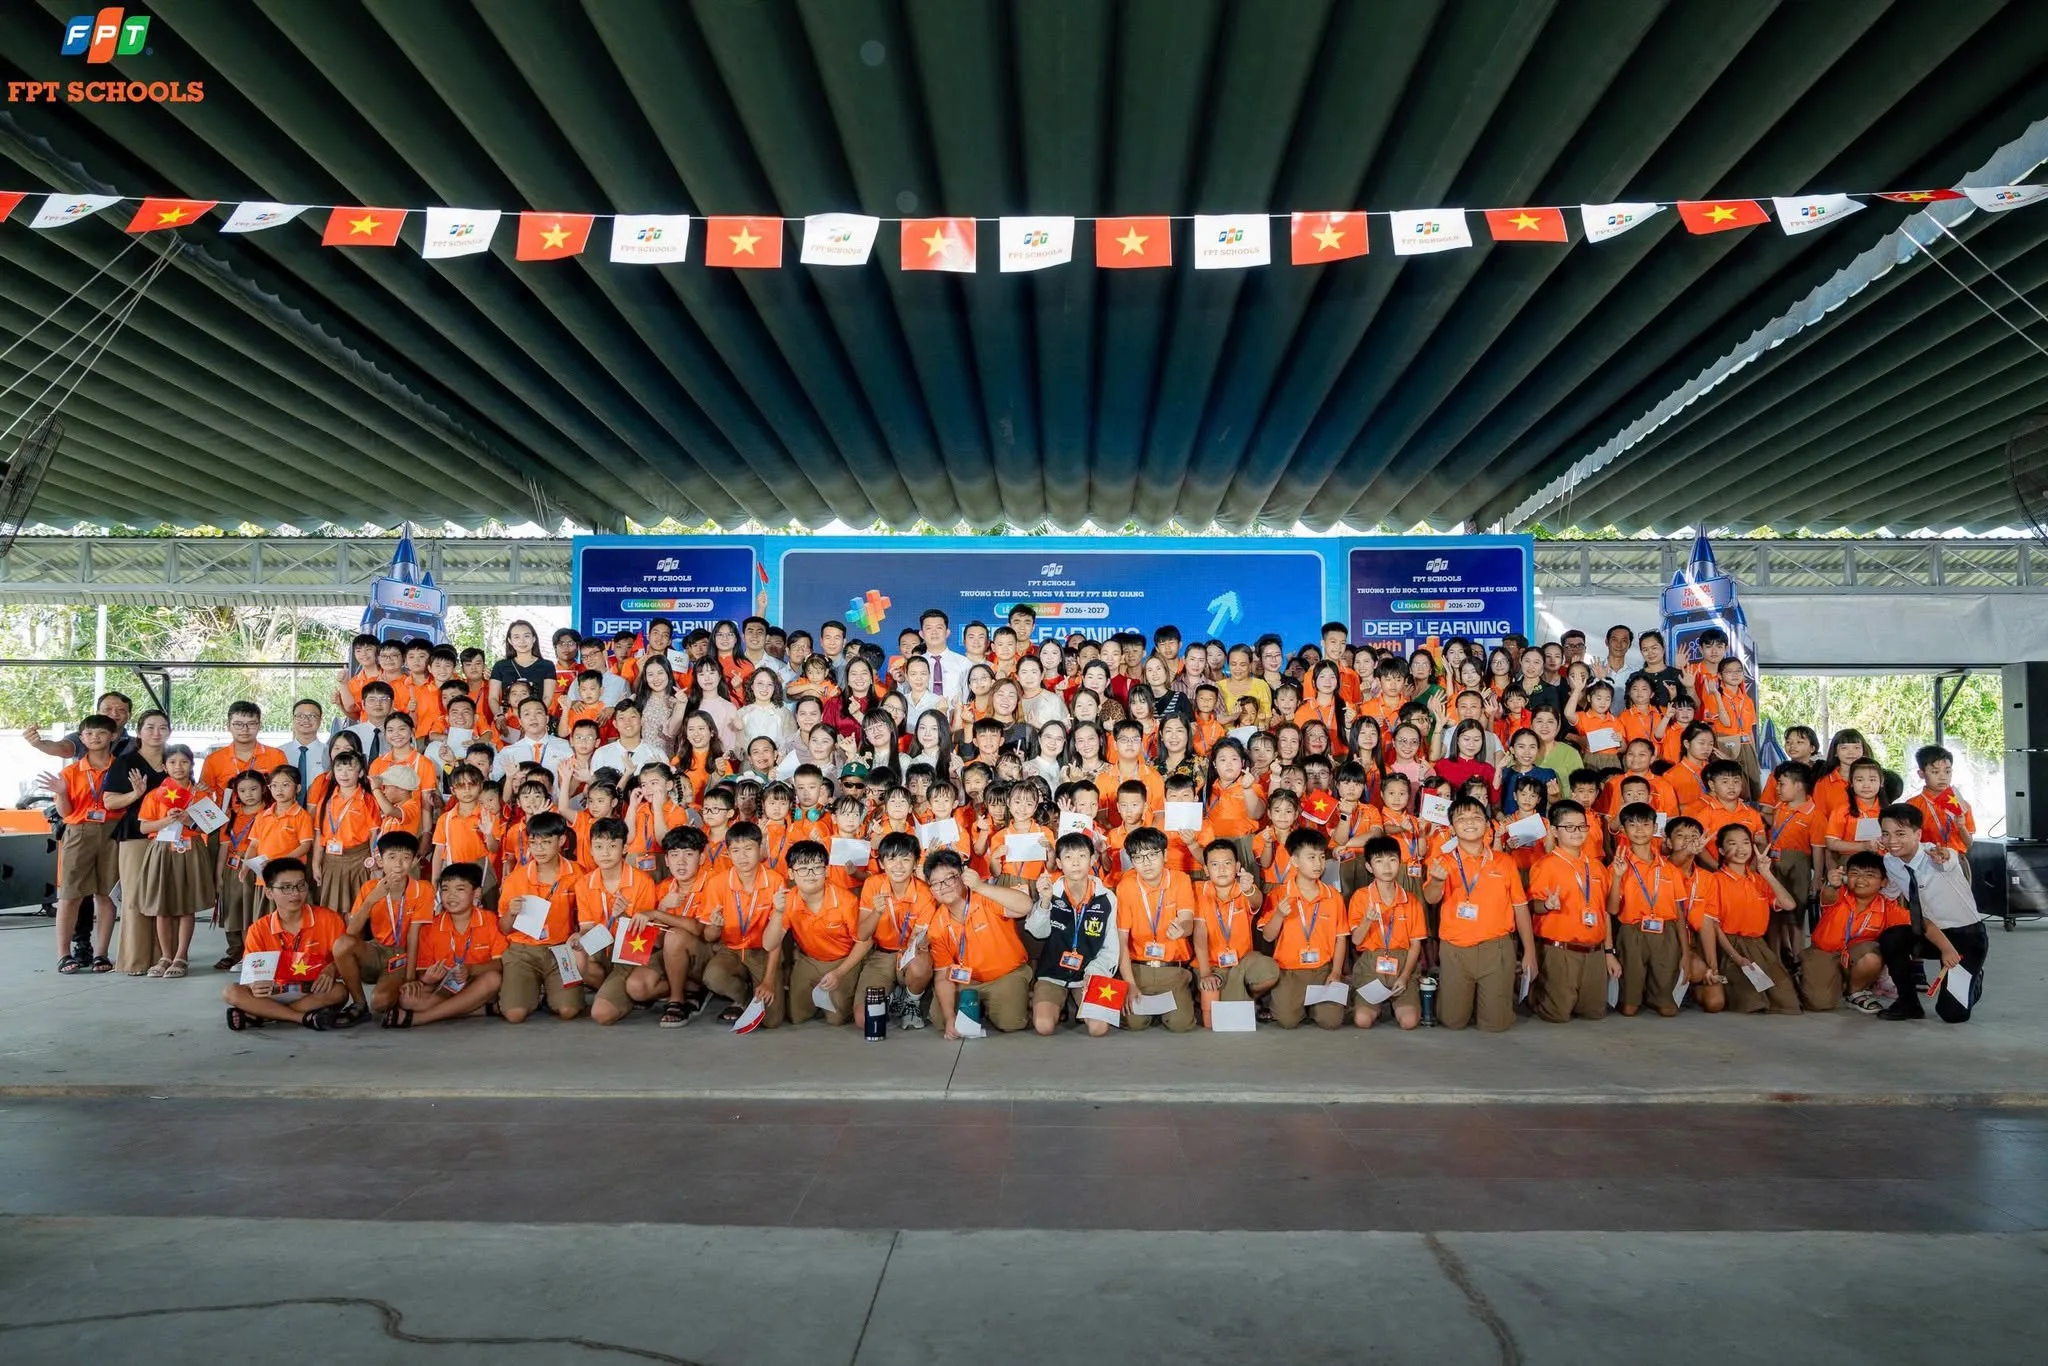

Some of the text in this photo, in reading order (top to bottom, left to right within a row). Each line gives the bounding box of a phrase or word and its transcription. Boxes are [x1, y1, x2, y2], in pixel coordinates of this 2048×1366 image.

[594, 620, 643, 634] DEEP
[1364, 621, 1511, 636] DEEP LEARNING
[1368, 639, 1402, 652] with
